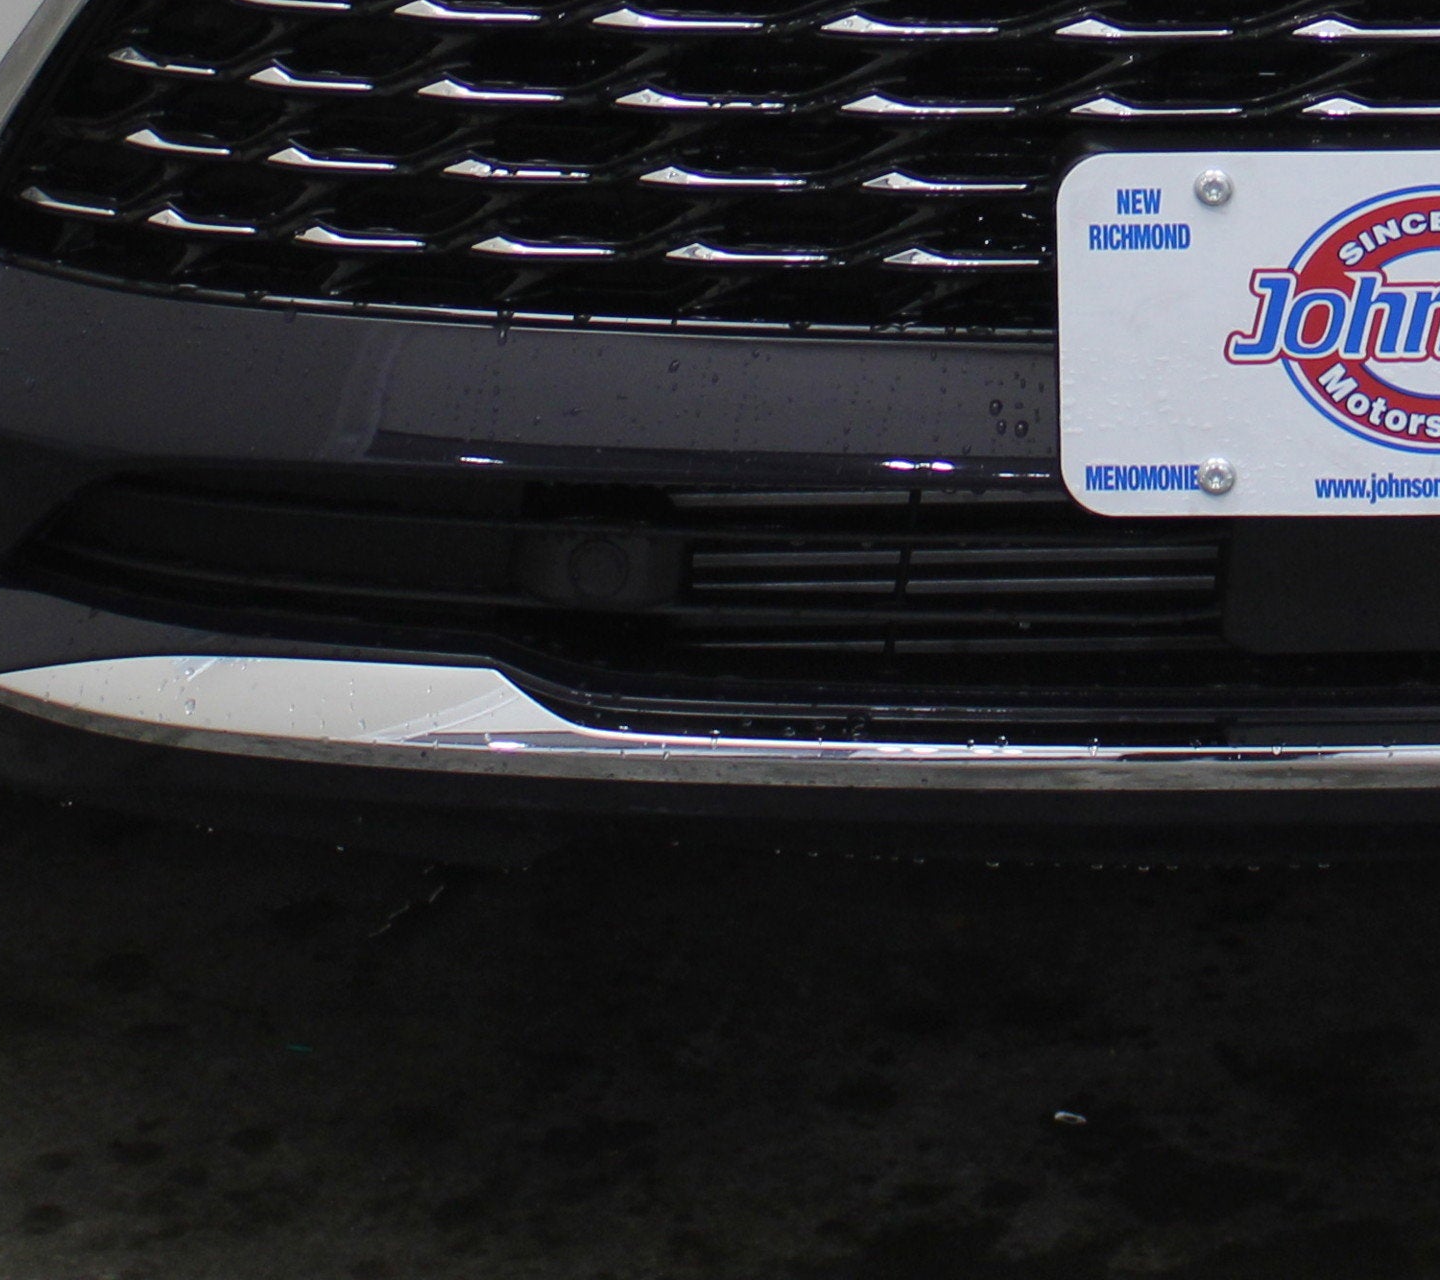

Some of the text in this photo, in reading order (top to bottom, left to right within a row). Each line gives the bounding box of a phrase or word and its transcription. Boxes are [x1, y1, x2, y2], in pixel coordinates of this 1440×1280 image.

[1116, 188, 1161, 215] NEW
[1089, 223, 1191, 251] RICHMOND
[1085, 465, 1201, 491] MENOMONIE
